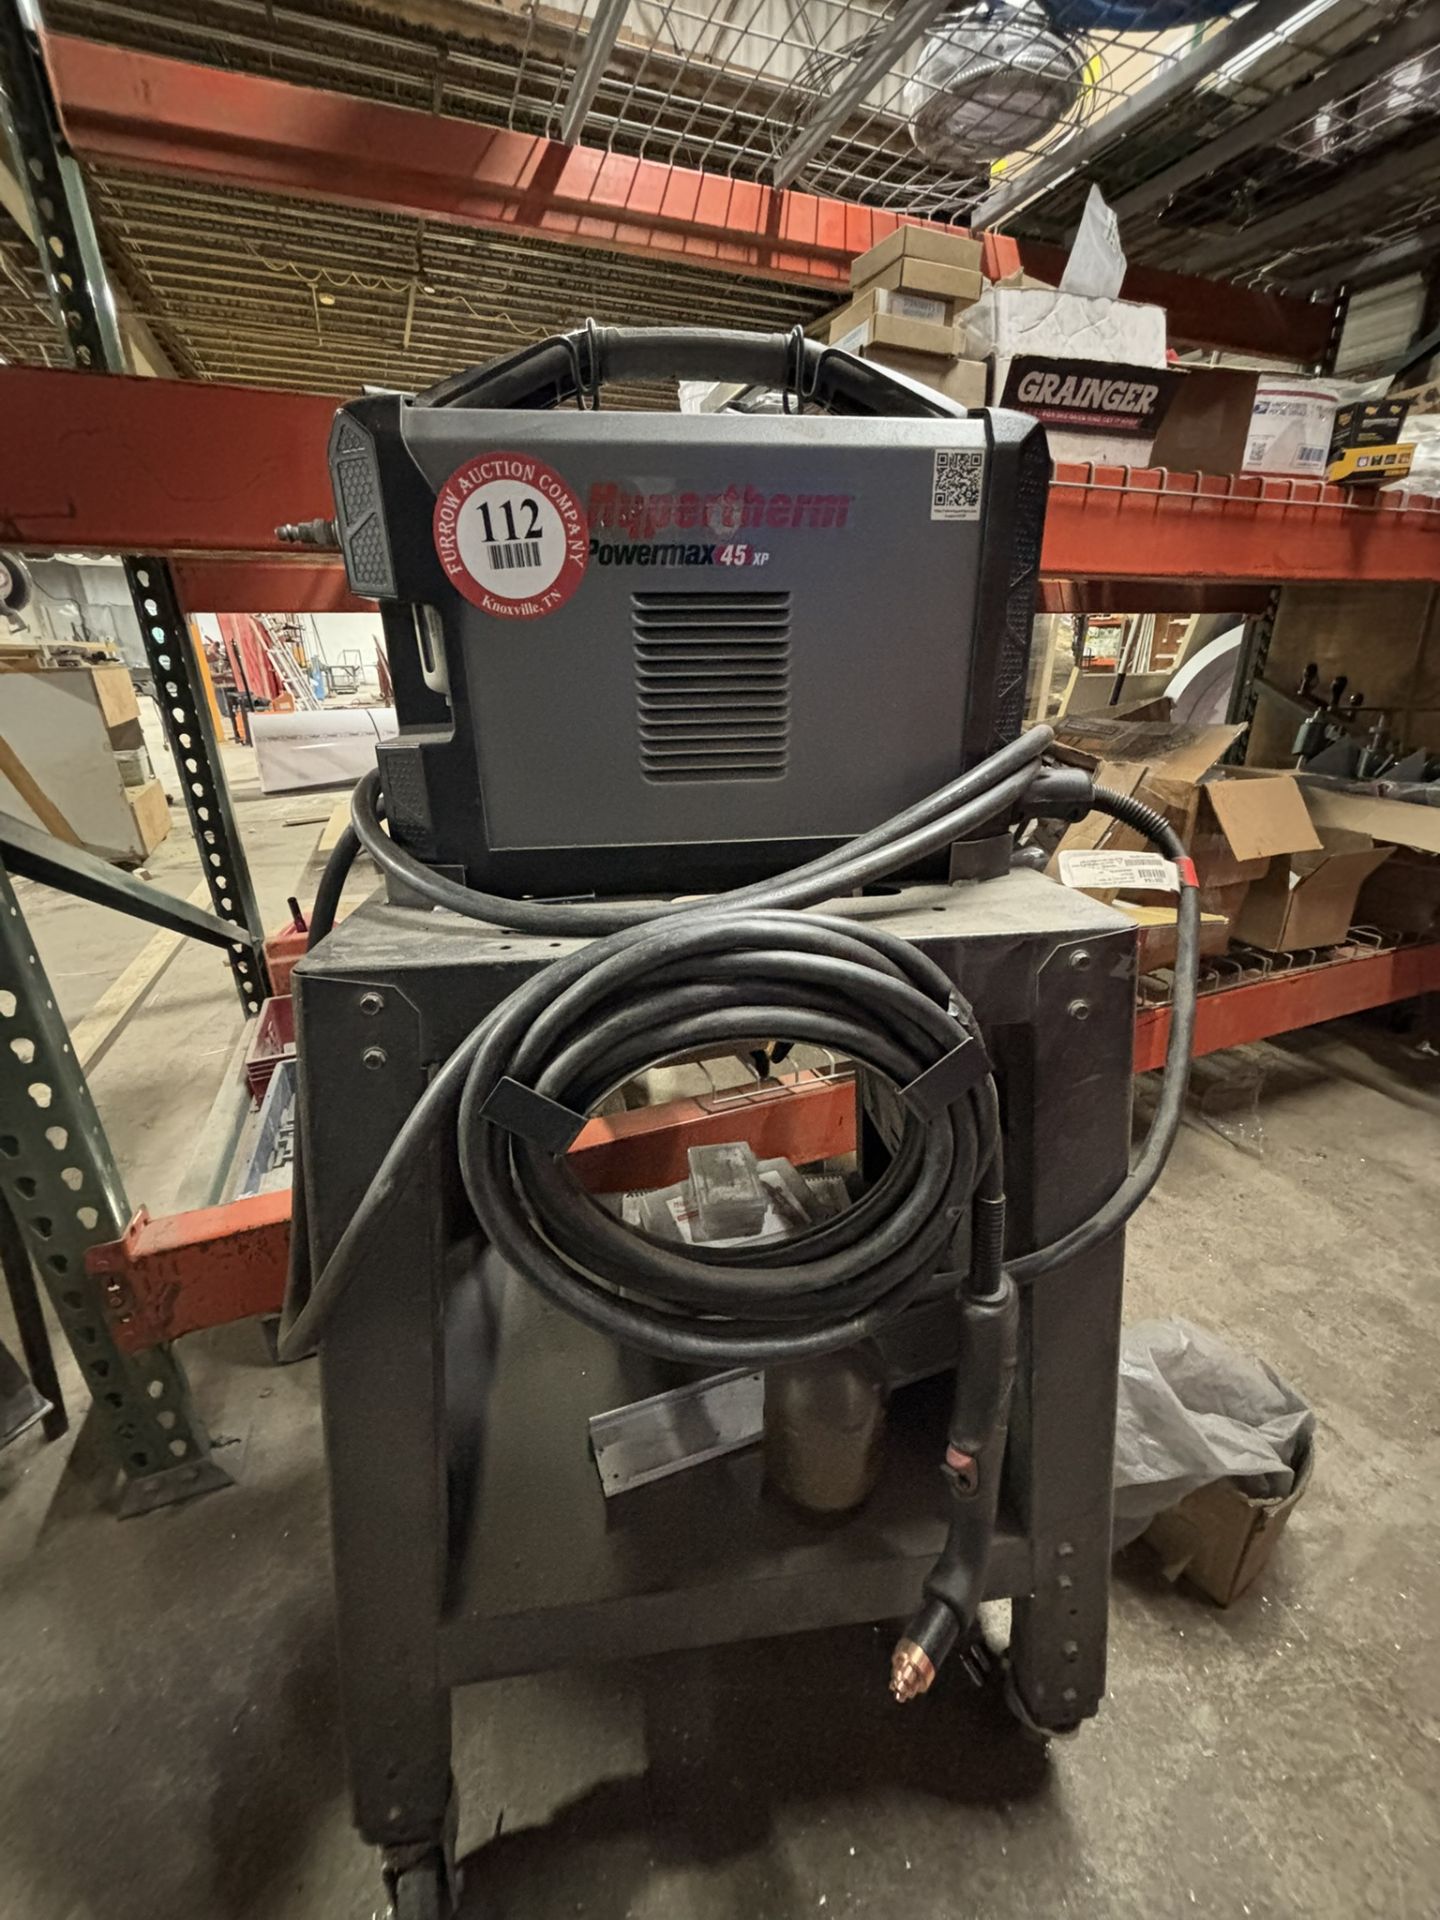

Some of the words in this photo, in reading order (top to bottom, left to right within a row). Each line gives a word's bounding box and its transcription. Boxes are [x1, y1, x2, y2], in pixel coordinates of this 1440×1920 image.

[1017, 371, 1159, 414] GRAINGER
[439, 488, 463, 575] FURROW
[458, 461, 536, 494] AUCTION
[476, 498, 544, 543] 112
[588, 484, 850, 539] Hypertherm
[720, 544, 748, 566] 45
[752, 553, 770, 566] XP
[482, 595, 544, 616] Knoxville,
[543, 588, 562, 608] TN
